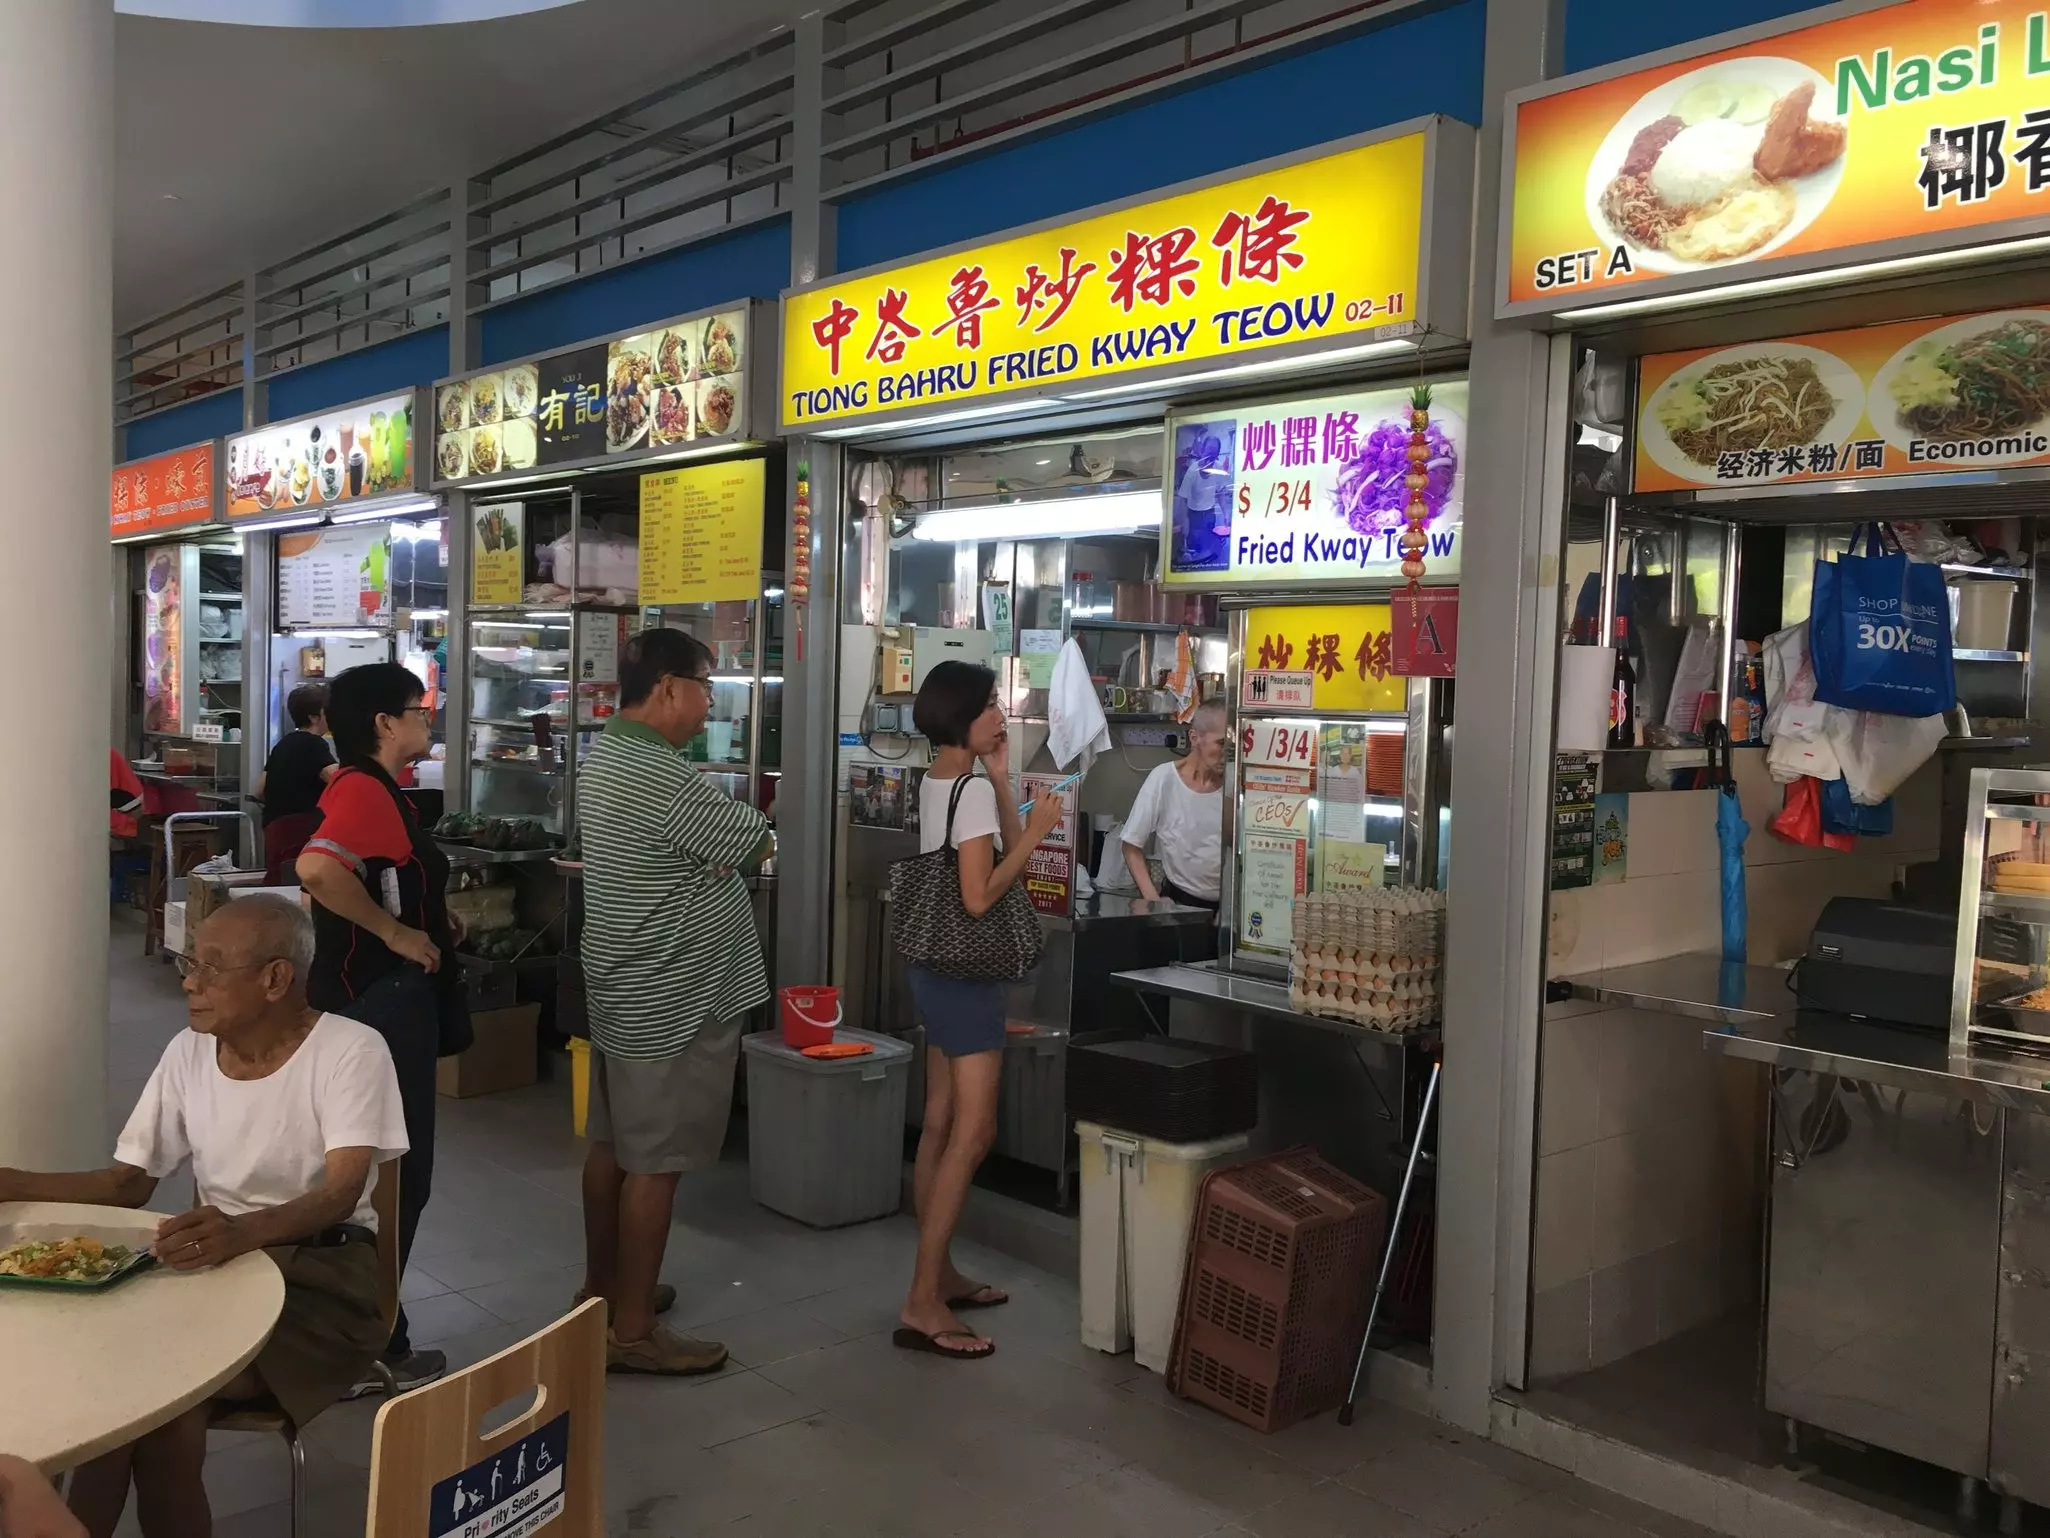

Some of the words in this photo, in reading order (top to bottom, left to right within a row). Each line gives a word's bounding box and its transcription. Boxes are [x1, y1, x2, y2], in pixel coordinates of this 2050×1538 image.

[1837, 25, 1997, 115] Nasi
[1536, 250, 1598, 288] SET
[1607, 245, 1632, 275] A
[812, 195, 1310, 376] 中峇魯炒粿條
[1345, 293, 1404, 322] 02-11
[792, 382, 867, 417] TIONG
[878, 361, 976, 403] BAHRU
[988, 343, 1078, 384] FRIED
[1092, 319, 1195, 367] KWAY
[1213, 292, 1334, 344] TEOW
[539, 384, 604, 431] 有記
[1241, 411, 1360, 471] 炒粿條
[1909, 431, 2048, 462] Economic
[1717, 439, 1886, 480] 经济米粉/面
[1238, 531, 1294, 565] Fried
[1304, 532, 1373, 568] Kway
[993, 593, 1008, 620] 25
[1859, 596, 1898, 610] SHOP
[1416, 614, 1447, 655] A
[1857, 624, 1911, 653] 30X
[1911, 635, 1937, 649] POINTS
[1270, 675, 1286, 684] Please
[1287, 675, 1303, 685] Queue
[1304, 676, 1311, 687] Up
[1243, 724, 1254, 757] $
[1255, 801, 1292, 823] CEOs
[1043, 832, 1066, 842] ERVICE
[1030, 849, 1069, 865] INGAPORE
[1044, 863, 1067, 876] FOODS
[1326, 860, 1375, 879] Award
[512, 1488, 539, 1514] Seats
[524, 1515, 540, 1532] THIS
[540, 1502, 559, 1521] CHAIR
